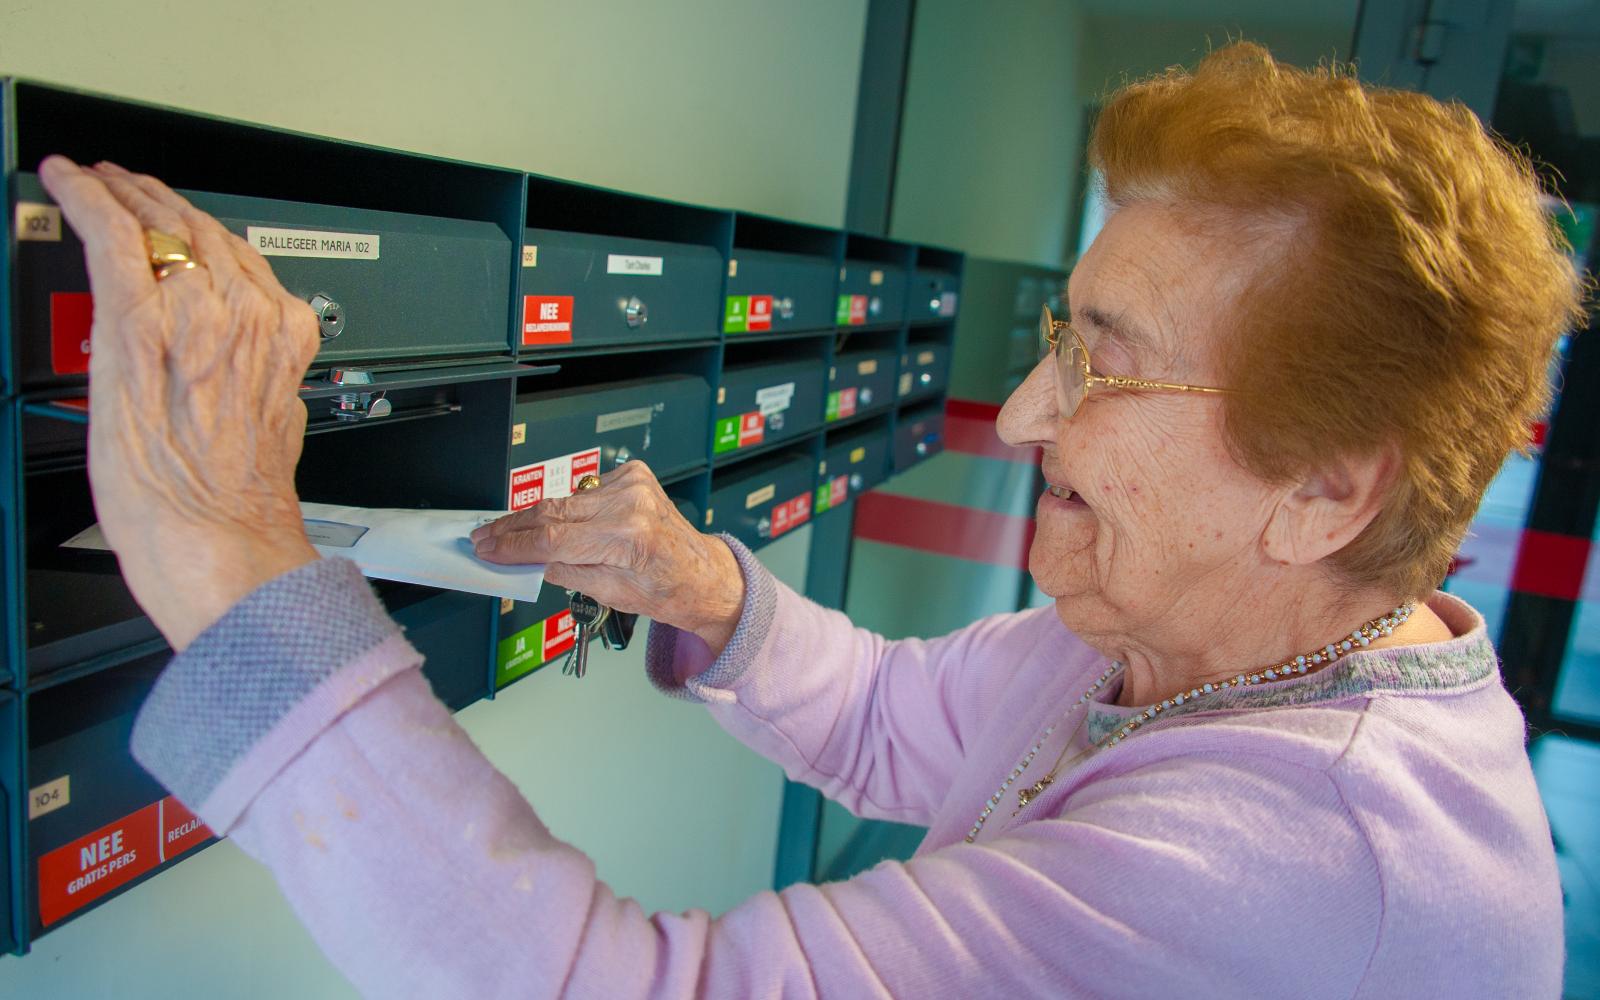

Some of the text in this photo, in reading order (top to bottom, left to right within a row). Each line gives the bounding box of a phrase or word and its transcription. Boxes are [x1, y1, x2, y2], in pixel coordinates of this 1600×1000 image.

[25, 216, 51, 233] 102
[260, 236, 369, 253] BALLEGEER MARIA 102
[540, 302, 559, 320] NEE
[513, 469, 543, 484] KRANTEN
[513, 486, 541, 508] NEEN
[35, 789, 60, 808] 104
[80, 829, 124, 871] NEE
[67, 849, 137, 895] GRATIS PERS
